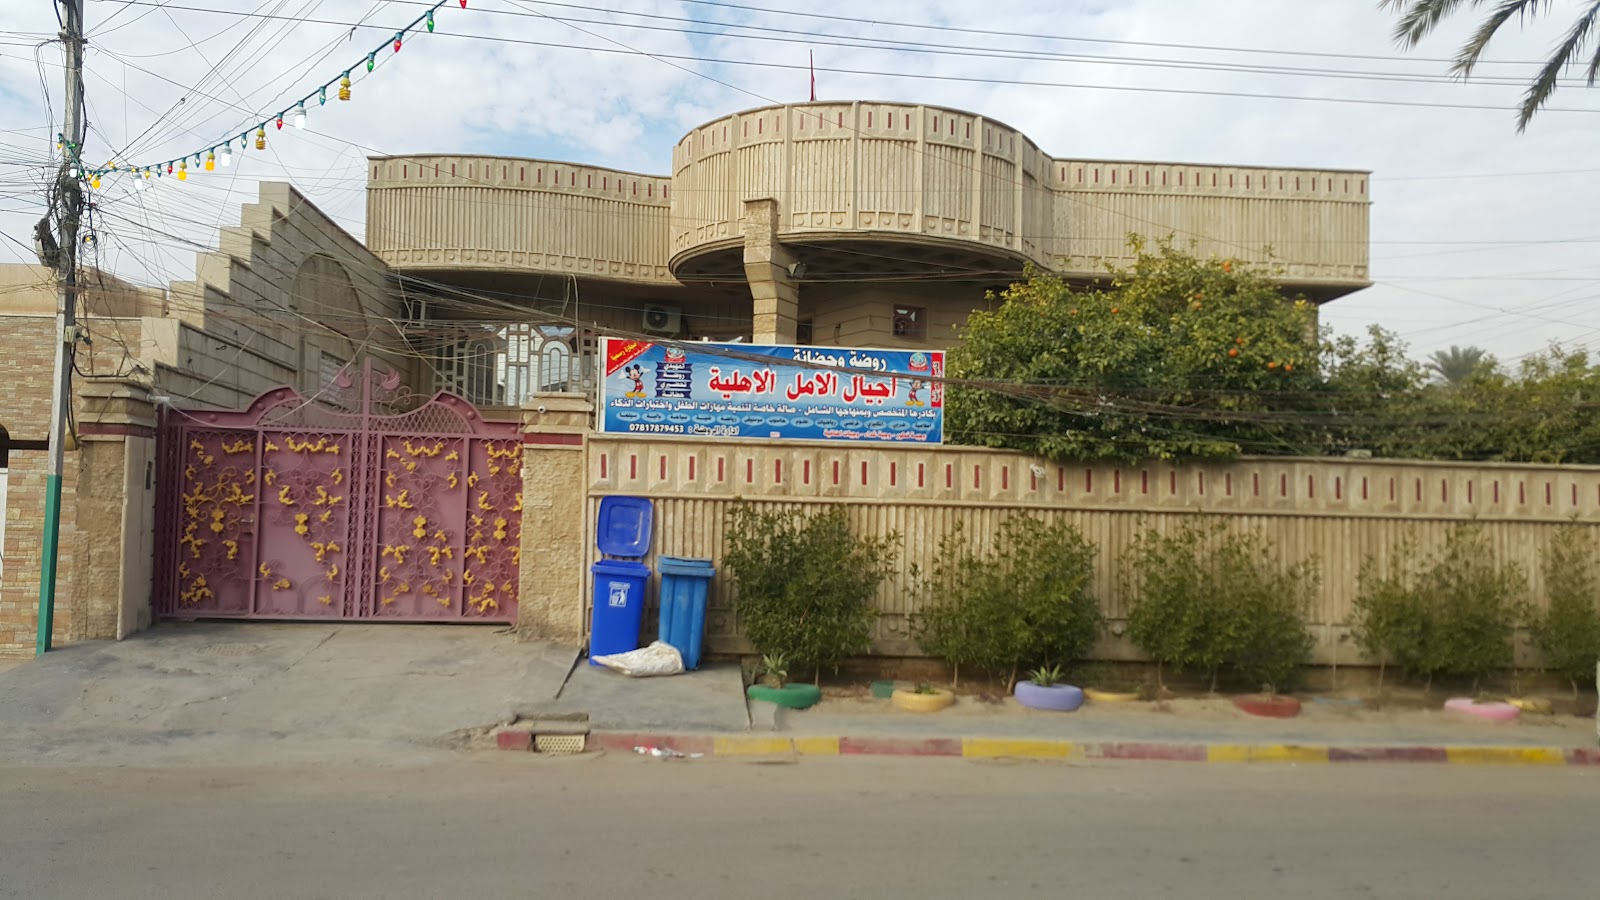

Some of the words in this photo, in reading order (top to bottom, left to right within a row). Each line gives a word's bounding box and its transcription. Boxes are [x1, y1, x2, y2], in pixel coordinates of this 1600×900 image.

[793, 348, 846, 368] وحضانة
[848, 350, 887, 371] روضة
[709, 367, 777, 401] الاهلية
[786, 371, 838, 401] الامل
[610, 398, 634, 408] الذكاء
[635, 399, 673, 411] واختبارات
[674, 400, 698, 411] الطفل
[700, 401, 726, 413] مهارات
[727, 402, 752, 414] لتنمية
[753, 402, 776, 413] خاصة
[777, 404, 796, 413] صالة
[804, 405, 834, 416] الشامل
[629, 422, 685, 433] 07817879453
[694, 424, 720, 436] الروضة
[721, 425, 740, 436] ادارة
